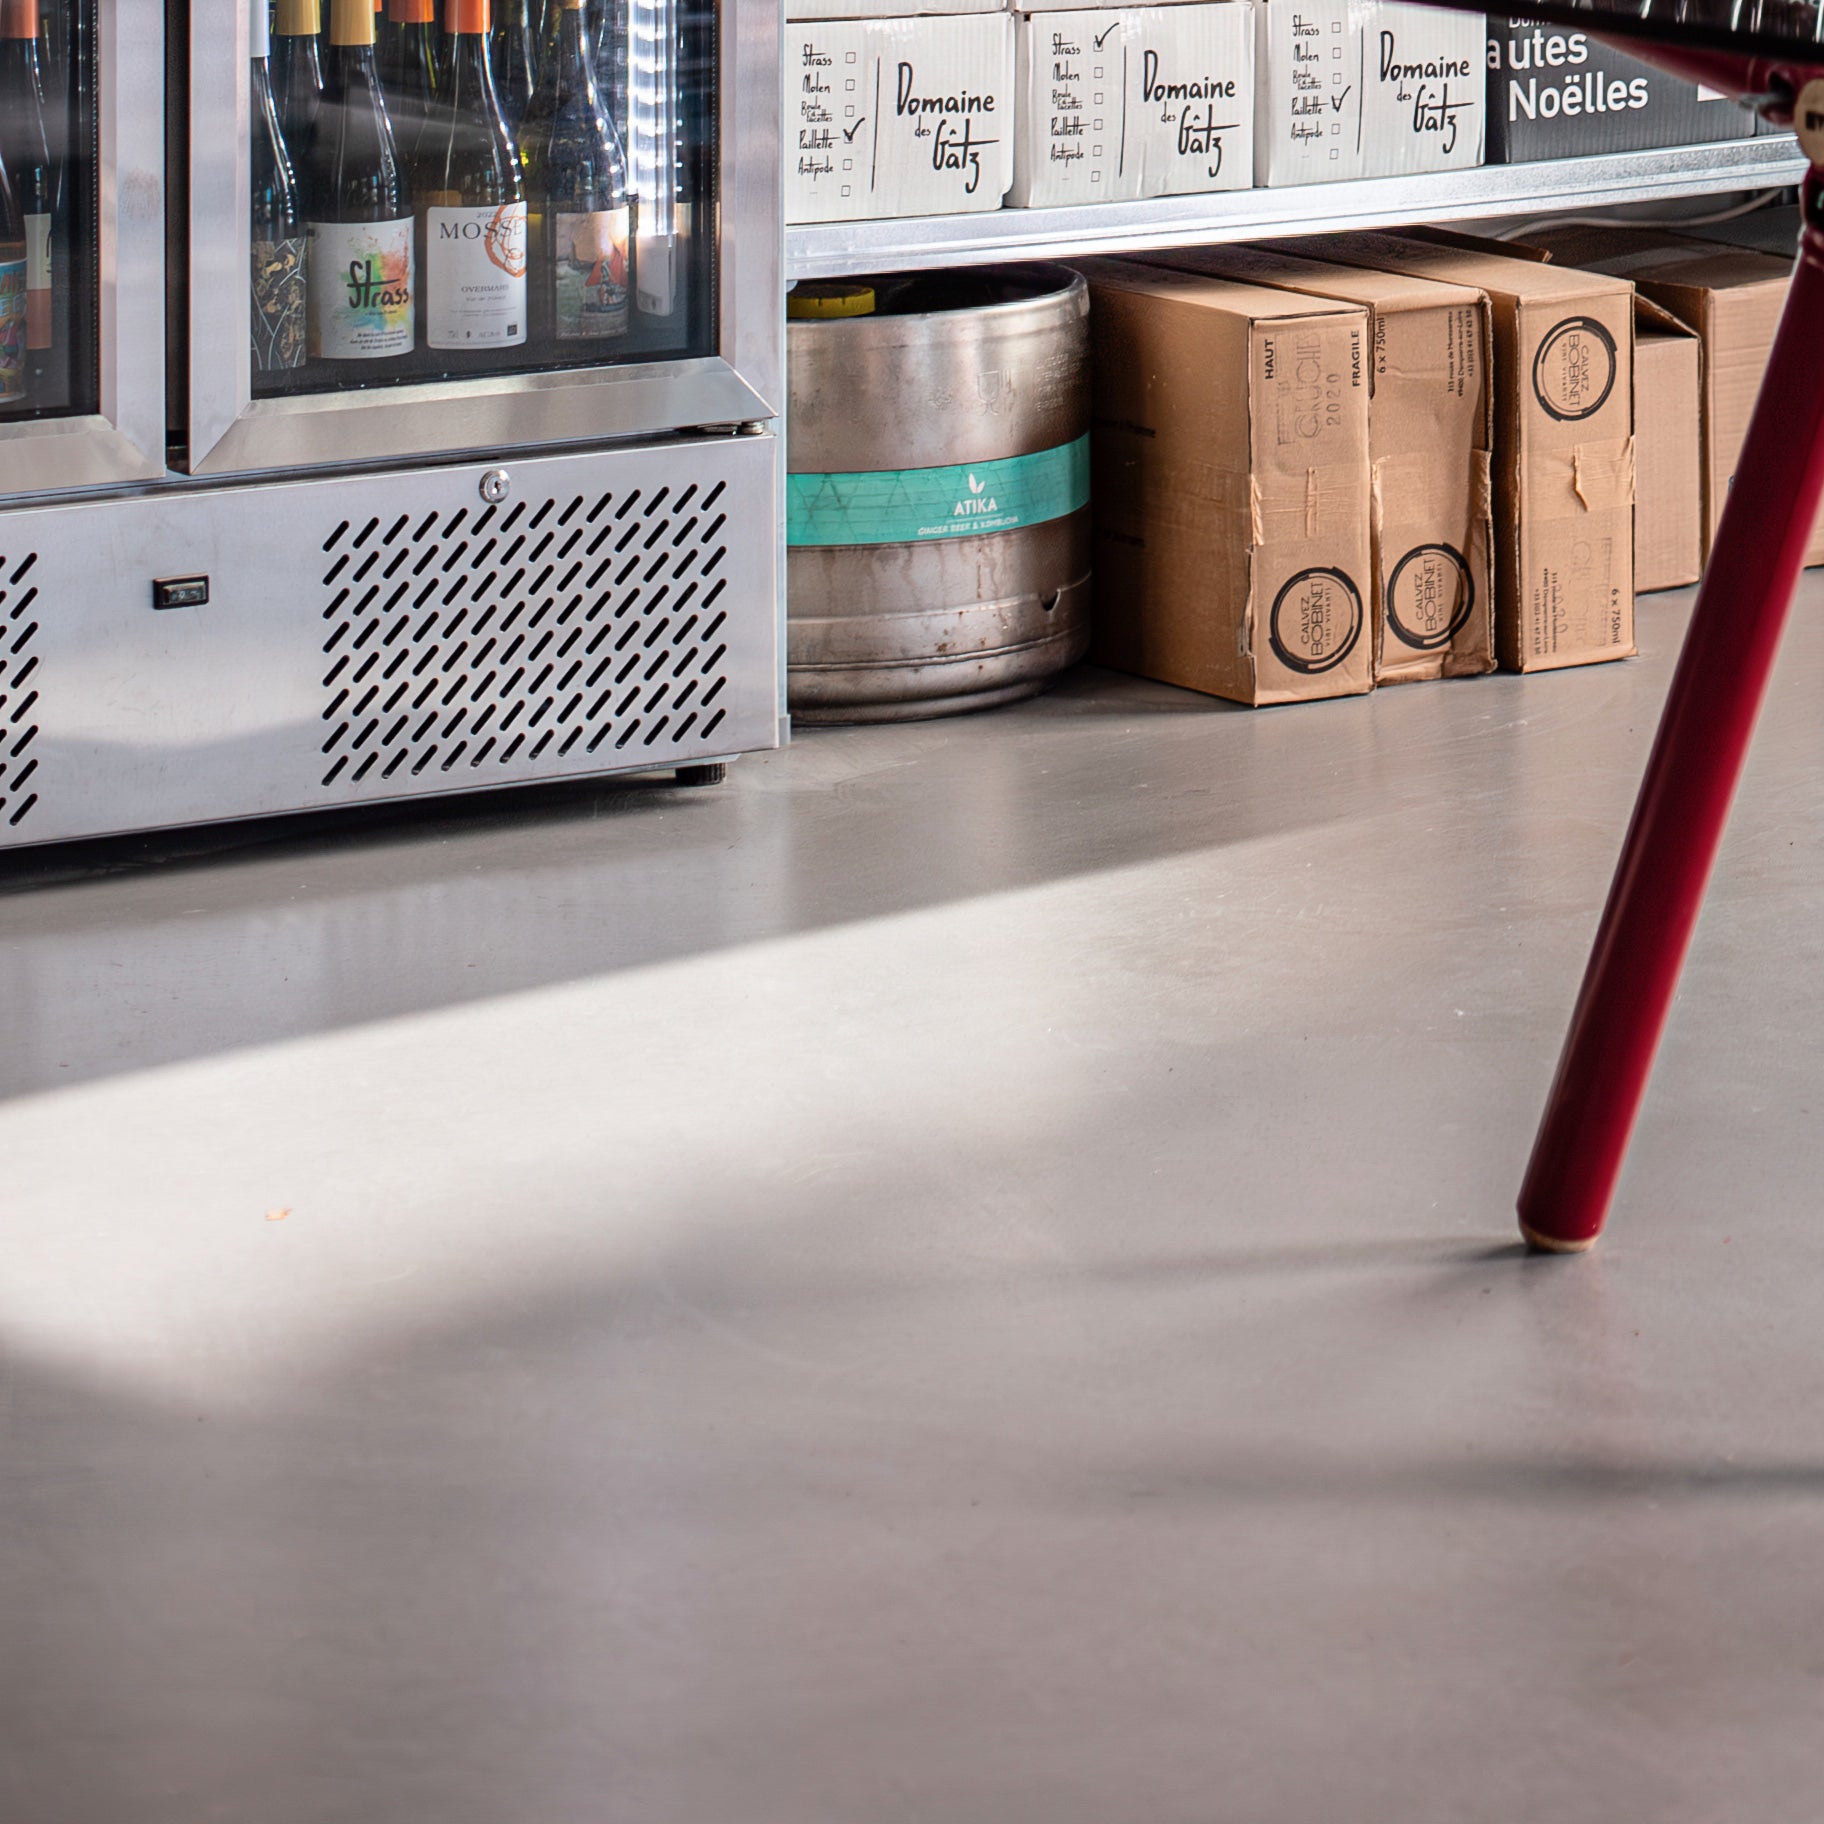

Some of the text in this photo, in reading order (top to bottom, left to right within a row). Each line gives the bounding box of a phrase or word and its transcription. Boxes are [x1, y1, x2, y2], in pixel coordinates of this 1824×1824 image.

[1292, 15, 1320, 37] Strass
[803, 44, 832, 67] Strass
[1052, 33, 1081, 56] Strass
[1293, 41, 1319, 62] Molen
[1380, 30, 1470, 82] Domaine
[802, 72, 831, 94] Molen
[1052, 60, 1080, 81] Molen
[1143, 49, 1236, 103] Domaine
[896, 61, 995, 116] Domaine
[1397, 81, 1412, 102] des
[1509, 71, 1649, 121] Noëlles
[1161, 101, 1176, 123] des
[1291, 95, 1330, 116] Paillette
[799, 129, 841, 150] Paillette
[915, 115, 931, 138] des
[1050, 116, 1091, 136] Paillette
[1290, 121, 1323, 146] Antipode
[798, 155, 834, 182] Antipode
[1050, 142, 1084, 168] Antipode
[347, 259, 409, 309] Strass
[1376, 317, 1386, 353] 750ml
[1265, 339, 1274, 380] HAUT
[1352, 330, 1360, 387] FRAGILE
[1569, 334, 1580, 406] BOBINET
[1581, 345, 1589, 391] CALVEZ
[1326, 373, 1341, 426] 2020
[954, 497, 998, 516] ATIKA
[1414, 574, 1423, 620] CALVEZ
[1424, 558, 1437, 632] BOBINET
[1301, 596, 1310, 645] CALVEZ
[1311, 582, 1323, 656] BOBINET
